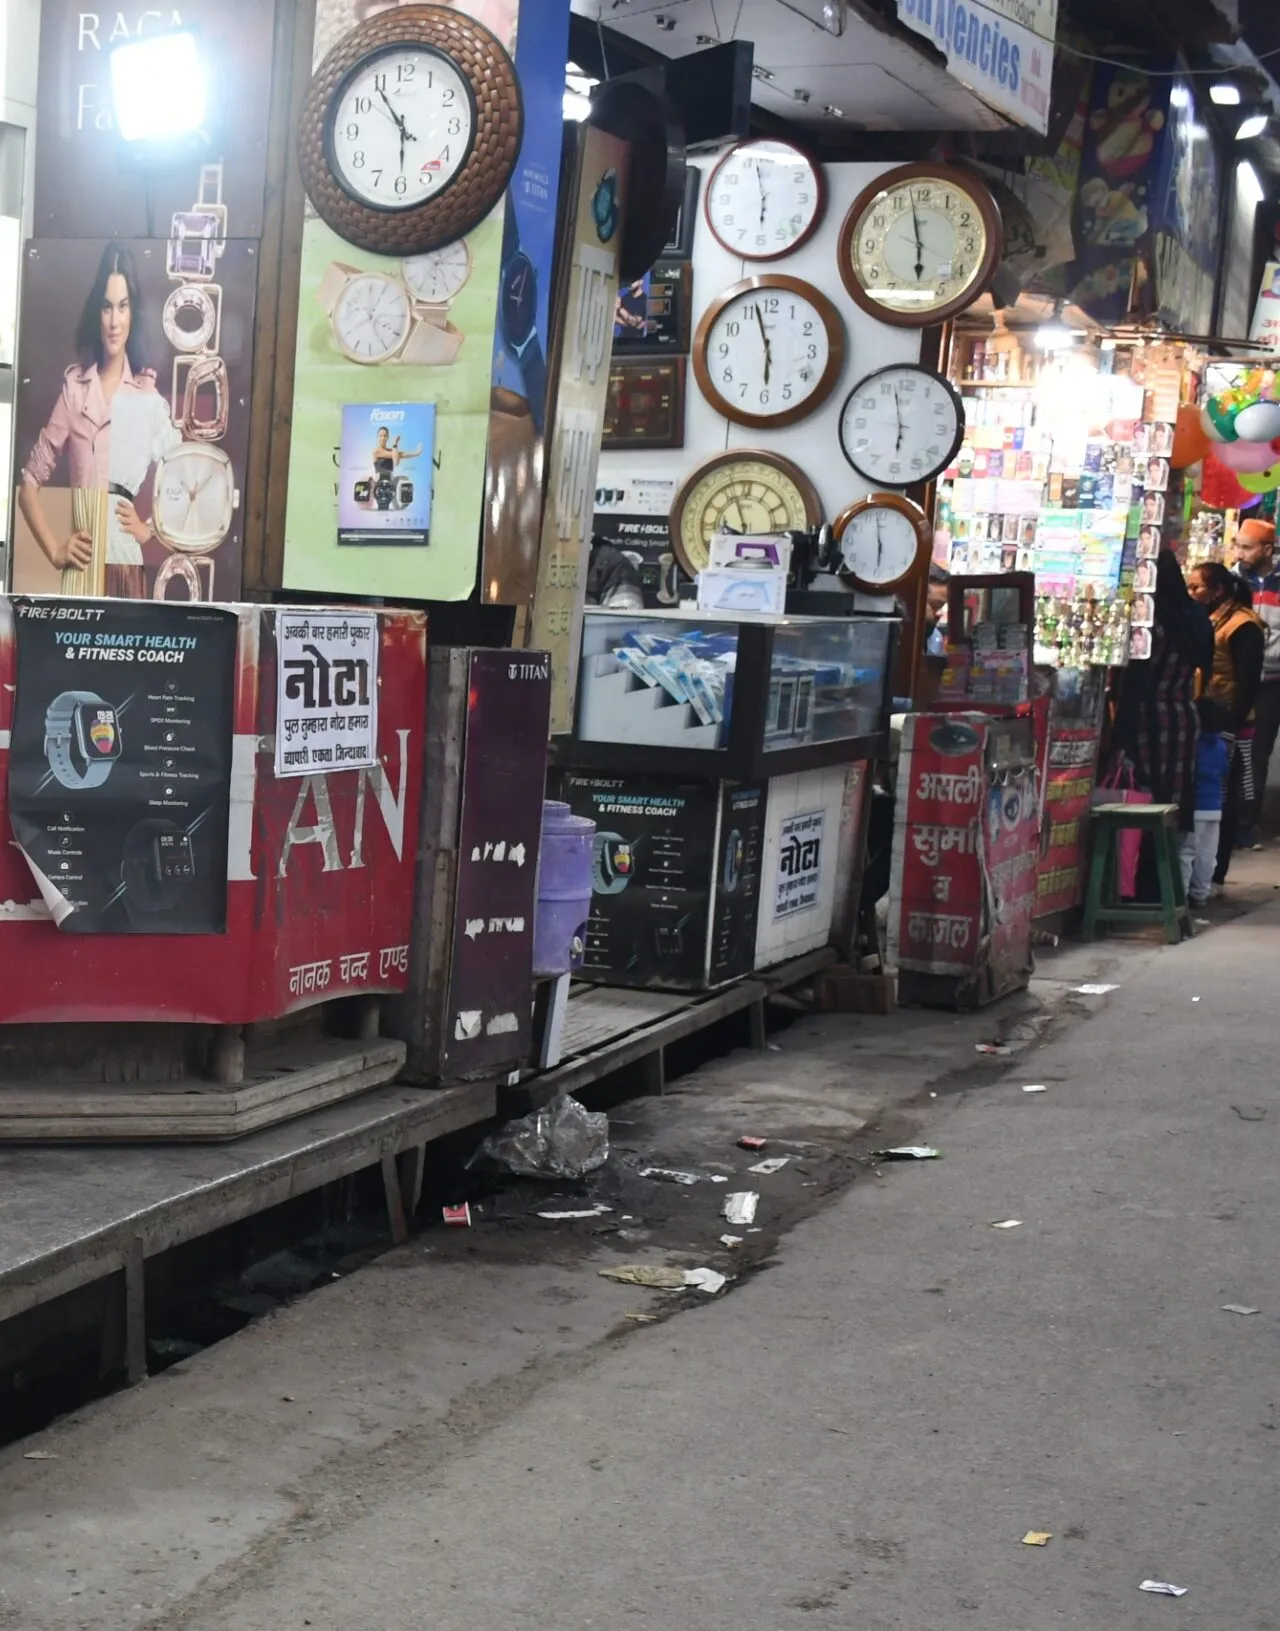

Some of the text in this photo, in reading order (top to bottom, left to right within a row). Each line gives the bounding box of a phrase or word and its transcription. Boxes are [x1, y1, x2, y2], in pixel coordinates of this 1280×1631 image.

[396, 64, 415, 82] 12
[427, 71, 433, 89] 1
[374, 74, 387, 92] 11
[355, 96, 372, 114] 10
[442, 89, 455, 107] 2
[347, 123, 359, 141] 9
[447, 116, 460, 135] 3
[353, 151, 365, 169] 8
[438, 144, 450, 163] 4
[371, 169, 383, 187] 7
[394, 176, 407, 194] 6
[55, 632, 197, 649] YOUR SMART HEALTH
[284, 621, 370, 646] अबकी बार हमारी पुकार
[65, 648, 185, 663] & FITNESS COACH
[284, 644, 369, 709] नोटा
[520, 664, 548, 679] TITAN
[284, 712, 368, 741] पुल तुम्हारा नोटा हमारा
[284, 746, 309, 765] व्यापारी
[312, 748, 332, 762] एकता
[916, 765, 982, 804] असली
[592, 794, 685, 808] YOUR SMART HEALTH
[598, 804, 677, 816] & FITNESS COACH
[781, 835, 820, 876] नोटा
[933, 875, 952, 902] व
[908, 912, 973, 948] काजल
[289, 945, 408, 996] नानक चन्द एण्ड
